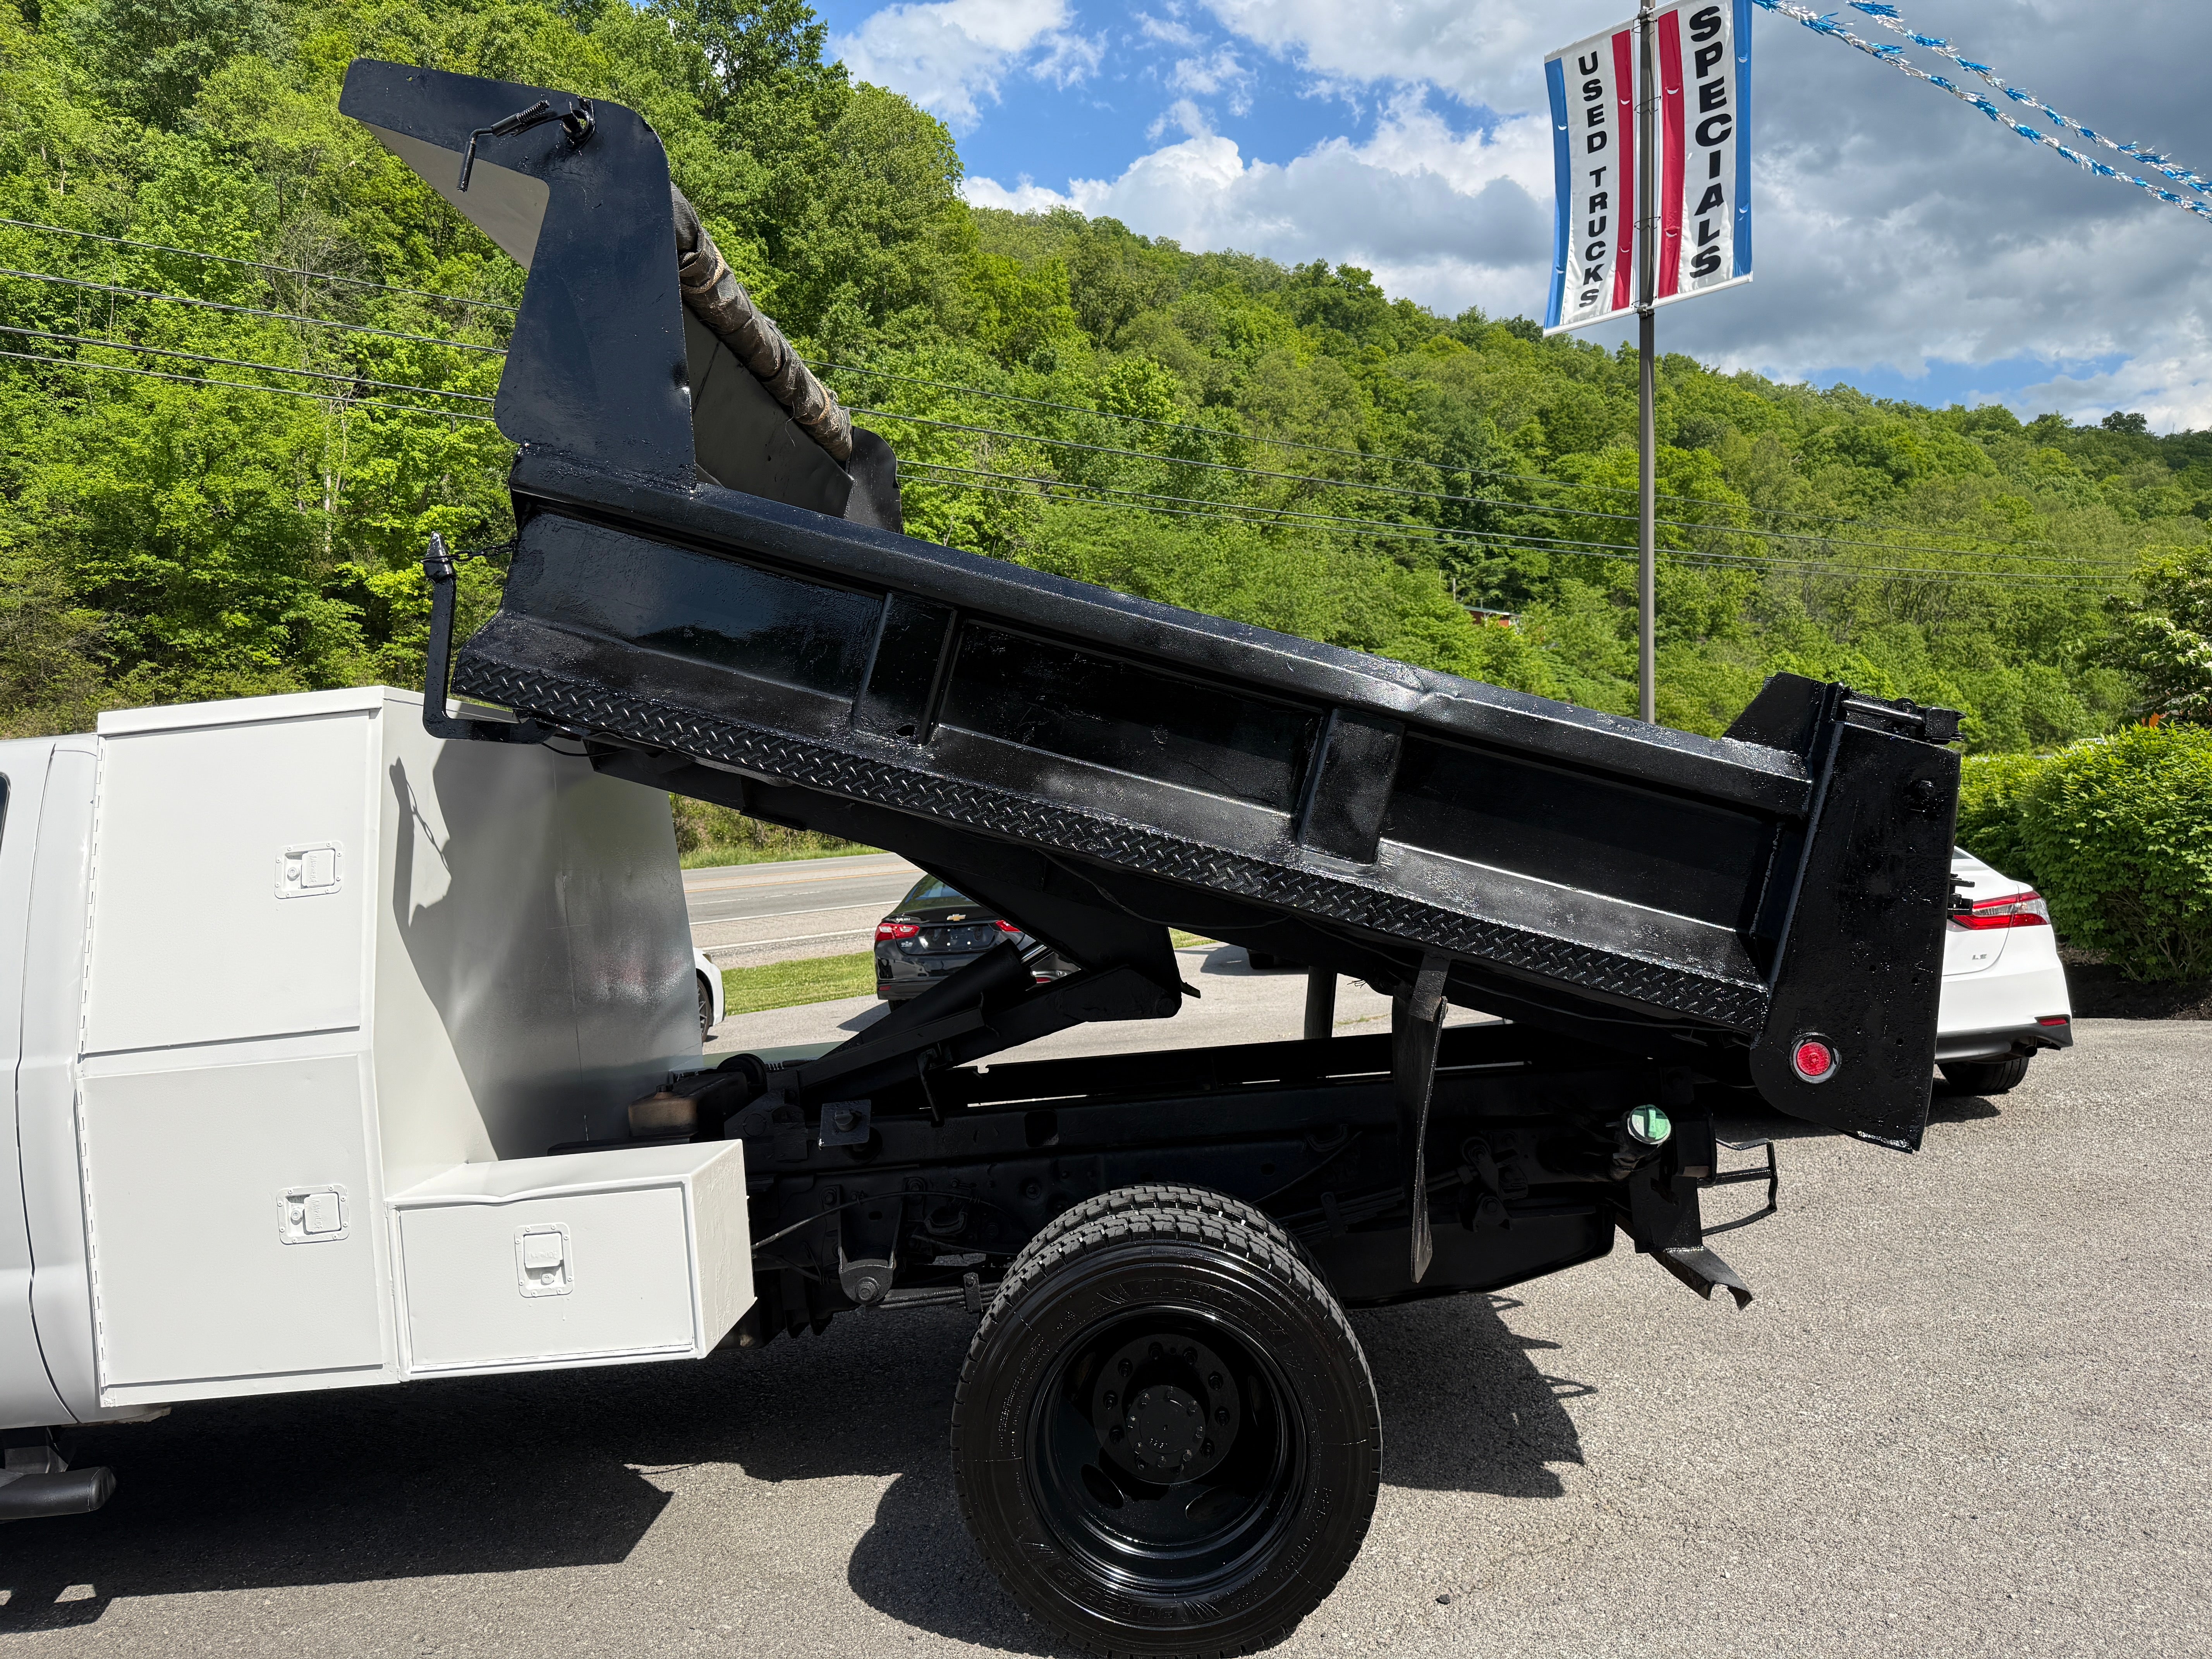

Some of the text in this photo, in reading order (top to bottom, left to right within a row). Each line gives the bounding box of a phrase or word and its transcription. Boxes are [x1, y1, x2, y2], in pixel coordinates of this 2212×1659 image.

[1578, 51, 1608, 308] USED TRUCKS
[1689, 5, 1732, 278] SPECIALS
